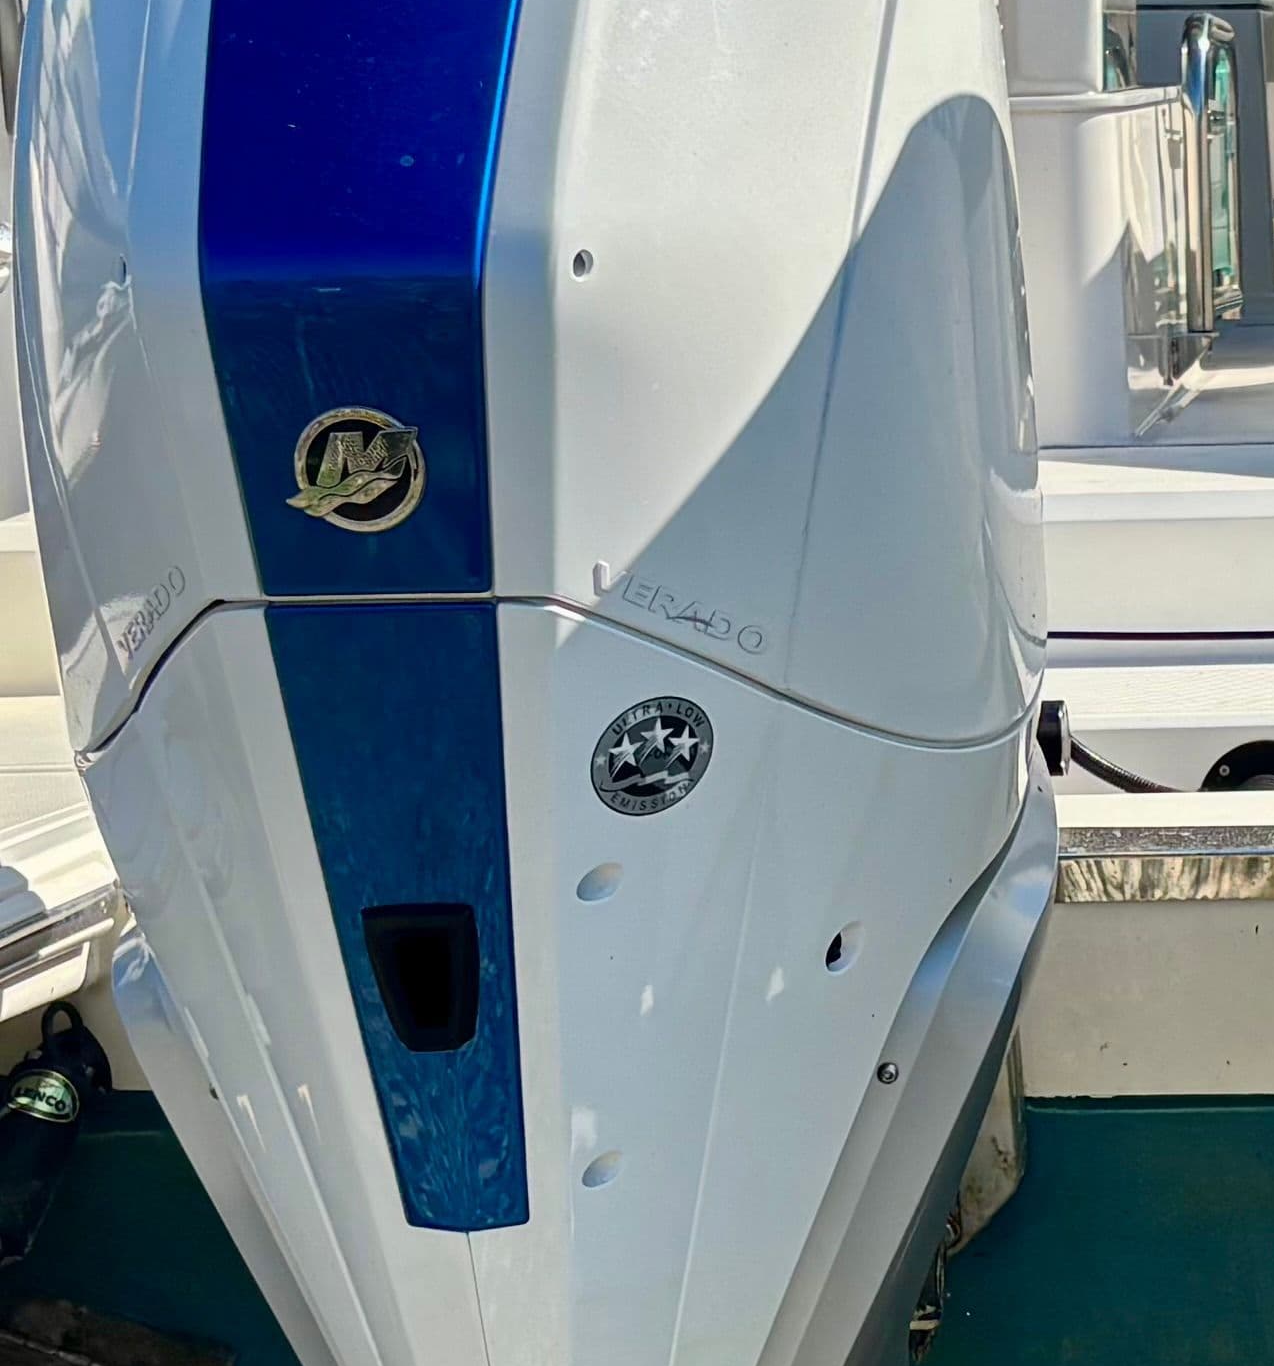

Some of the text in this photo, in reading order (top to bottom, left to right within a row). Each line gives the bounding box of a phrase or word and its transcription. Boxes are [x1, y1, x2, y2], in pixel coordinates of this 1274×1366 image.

[116, 564, 186, 660] VERADO
[592, 560, 768, 655] VERADO
[676, 702, 706, 728] LOW
[609, 781, 692, 811] EMISSION
